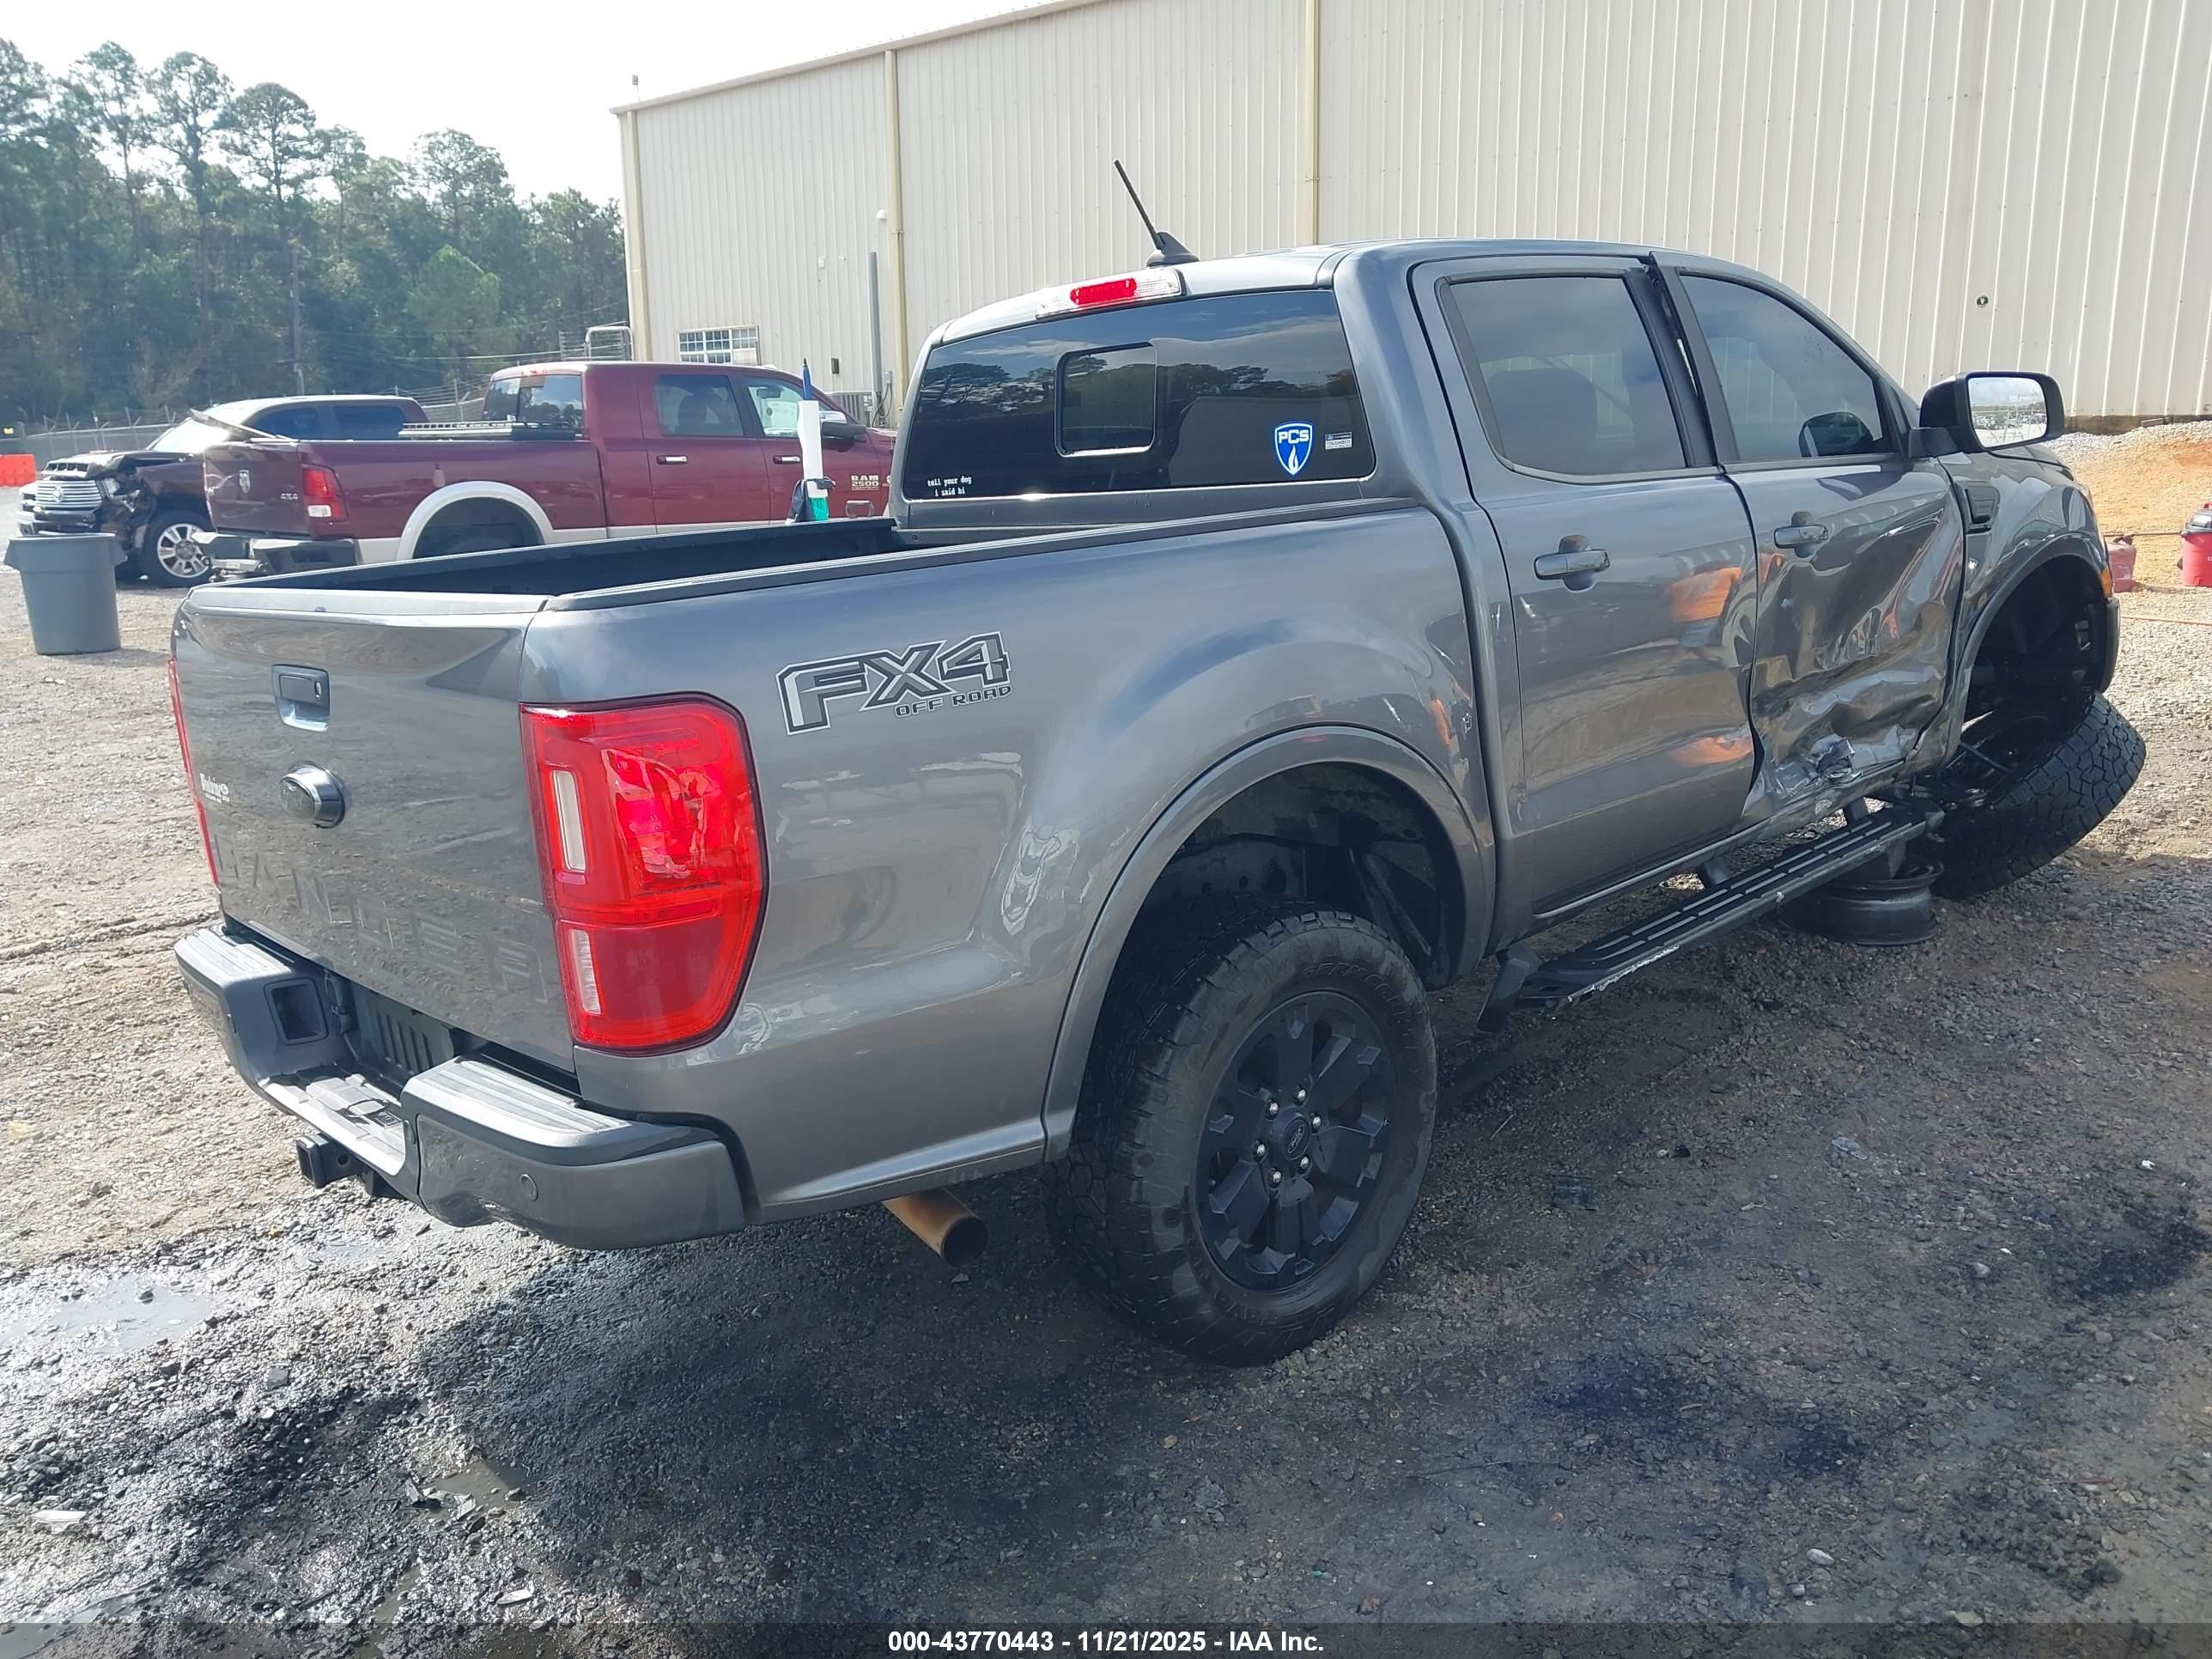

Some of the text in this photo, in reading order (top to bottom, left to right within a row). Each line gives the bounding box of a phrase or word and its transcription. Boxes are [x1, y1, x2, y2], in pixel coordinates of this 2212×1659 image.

[1278, 429, 1310, 444] PCS
[927, 475, 972, 487] tell your dog
[941, 487, 956, 495] said
[957, 485, 966, 495] hi
[775, 630, 1012, 735] FX4
[894, 685, 1012, 718] OFF ROAD
